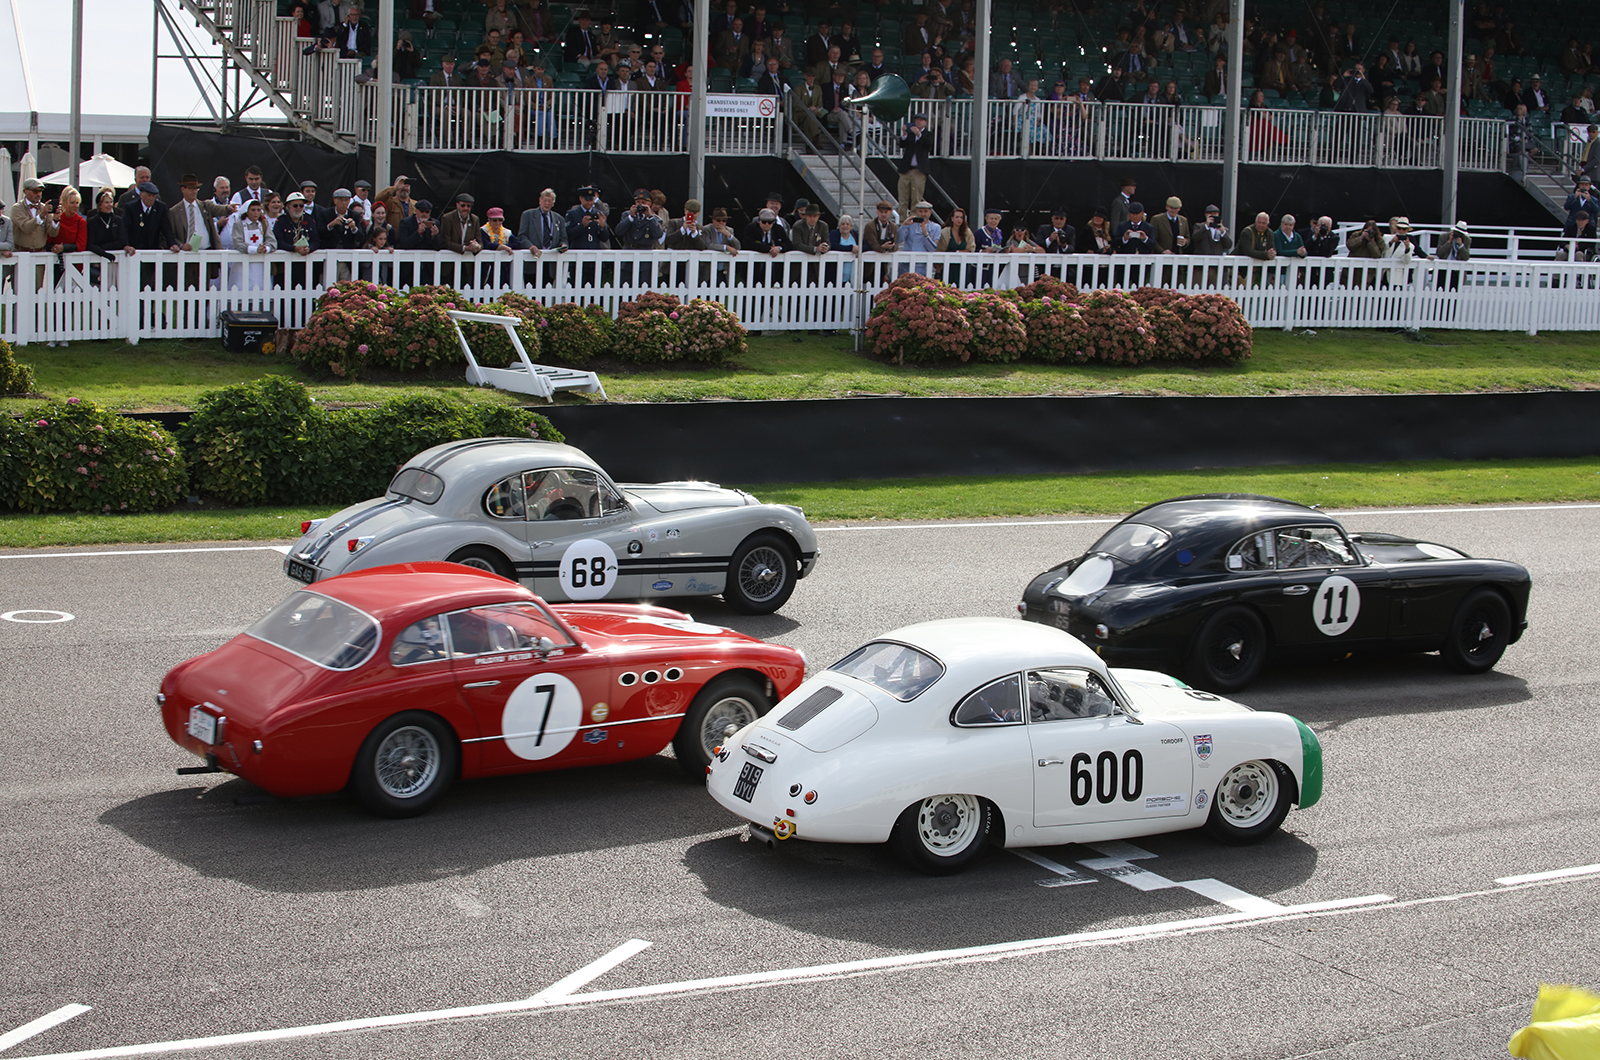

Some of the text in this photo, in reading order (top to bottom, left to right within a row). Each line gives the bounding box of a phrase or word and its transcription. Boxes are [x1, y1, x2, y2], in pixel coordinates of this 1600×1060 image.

[572, 556, 606, 588] 68
[1321, 585, 1349, 625] 11
[534, 684, 556, 747] 7
[735, 781, 756, 801] UYU
[741, 763, 763, 784] 919
[1070, 749, 1143, 806] 600
